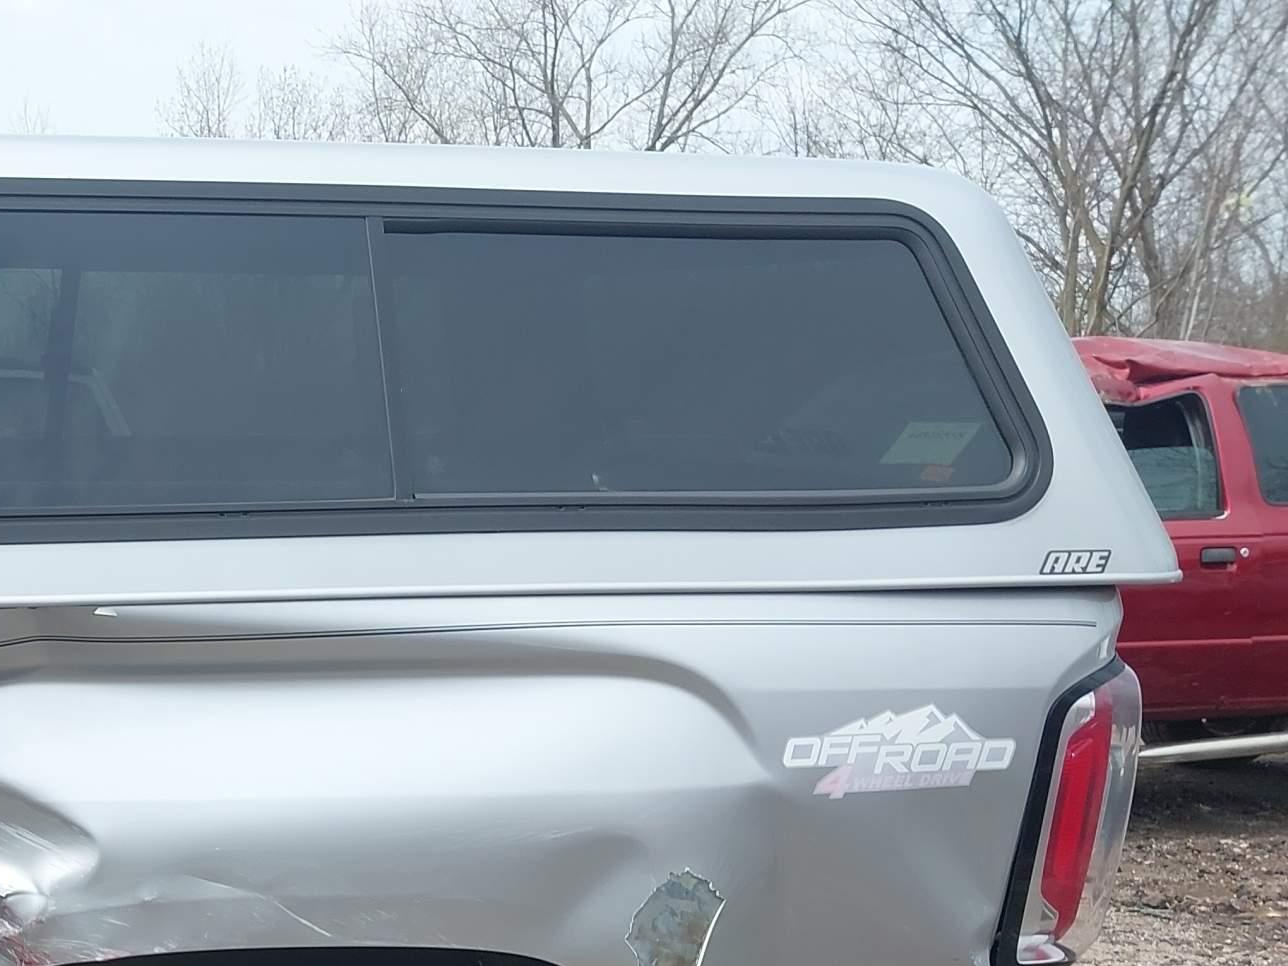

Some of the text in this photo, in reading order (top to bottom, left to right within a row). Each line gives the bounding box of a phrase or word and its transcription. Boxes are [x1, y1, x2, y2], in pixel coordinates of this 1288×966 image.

[1040, 550, 1111, 575] ARE
[813, 764, 854, 799] 4
[852, 773, 912, 790] WHEEL
